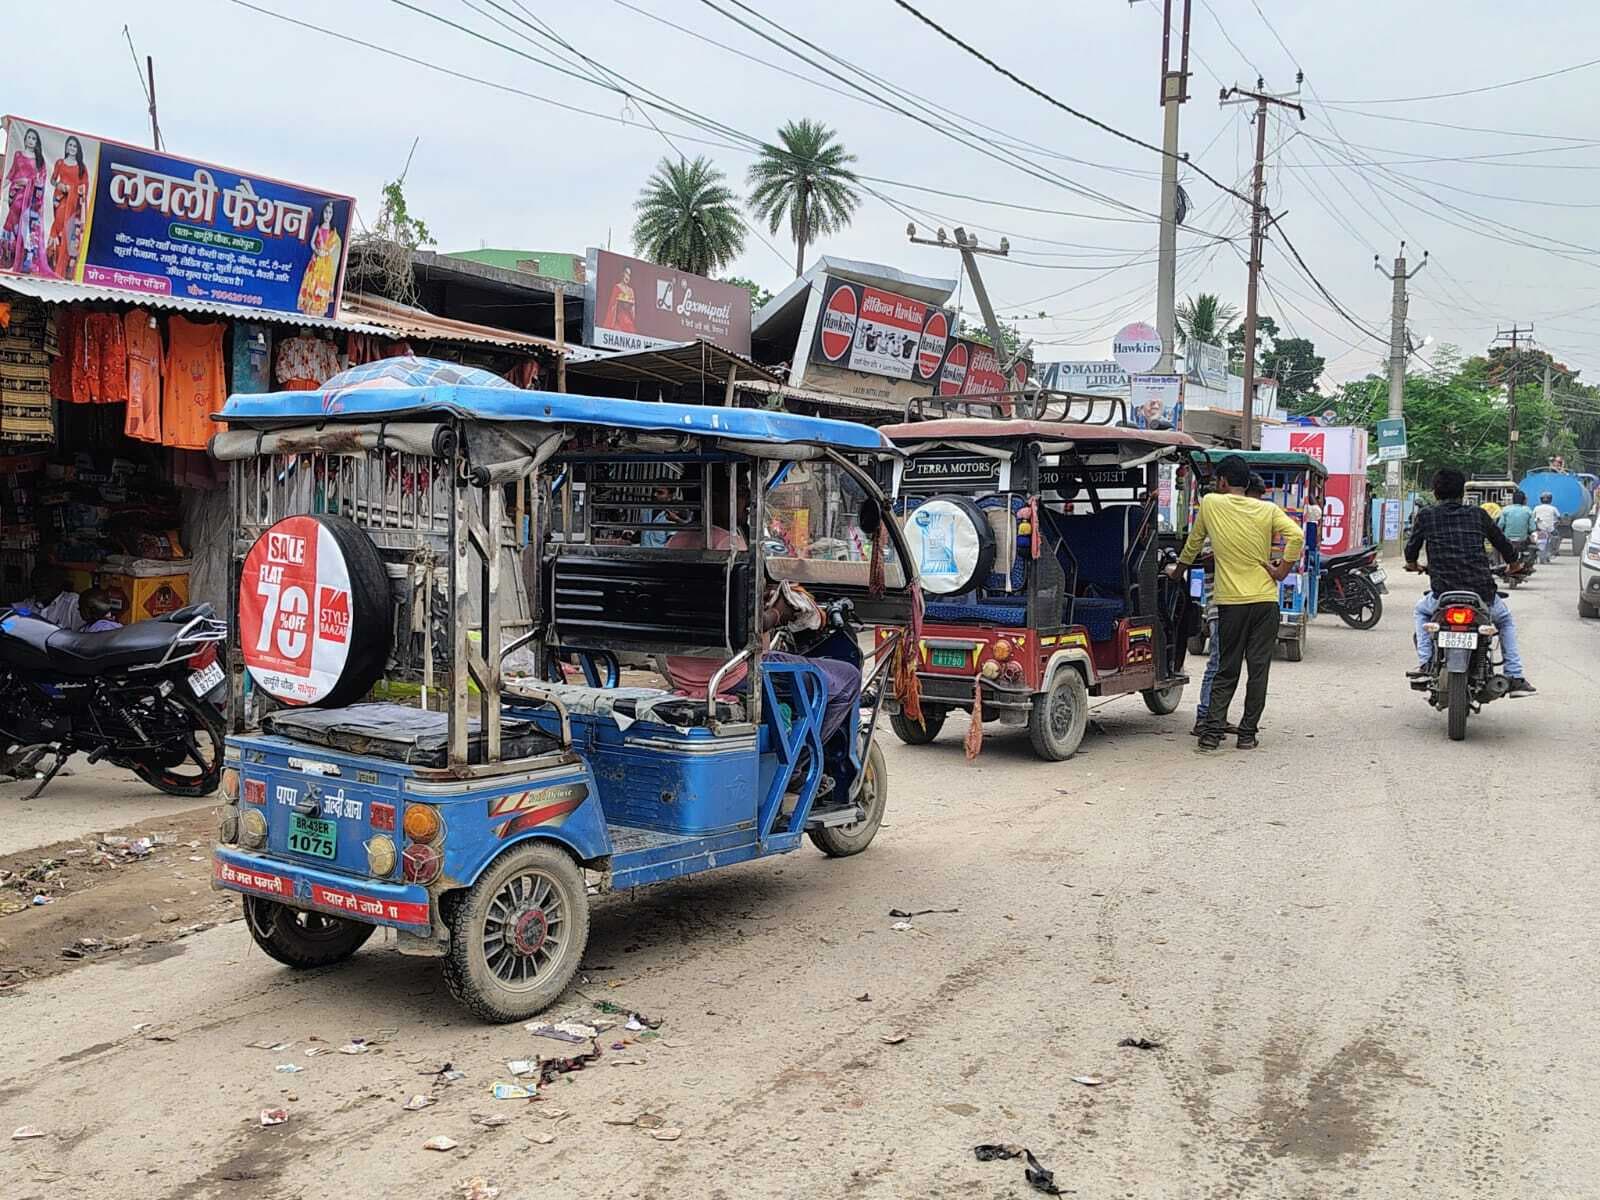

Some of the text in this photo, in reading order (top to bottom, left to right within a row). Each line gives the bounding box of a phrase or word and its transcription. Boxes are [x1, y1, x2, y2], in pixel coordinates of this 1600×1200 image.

[110, 163, 312, 240] लवली फैशन
[113, 272, 141, 286] दिलीप
[143, 276, 166, 290] पंडित
[895, 302, 922, 322] Hawkins
[824, 311, 854, 334] Hawkins
[602, 333, 641, 350] SHANKAR
[920, 336, 945, 354] Hawkins
[1113, 342, 1161, 353] Hawkins
[943, 364, 965, 381] Hawkins
[1072, 364, 1124, 375] MADHE
[917, 462, 990, 474] TERRA MOTORS
[271, 536, 305, 564] SALE
[259, 564, 285, 584] FLAT
[256, 584, 309, 659] 70
[320, 608, 349, 626] STYLE
[276, 785, 363, 820] पापा जल्दी आना
[289, 835, 333, 856] 1075
[345, 895, 358, 911] हो
